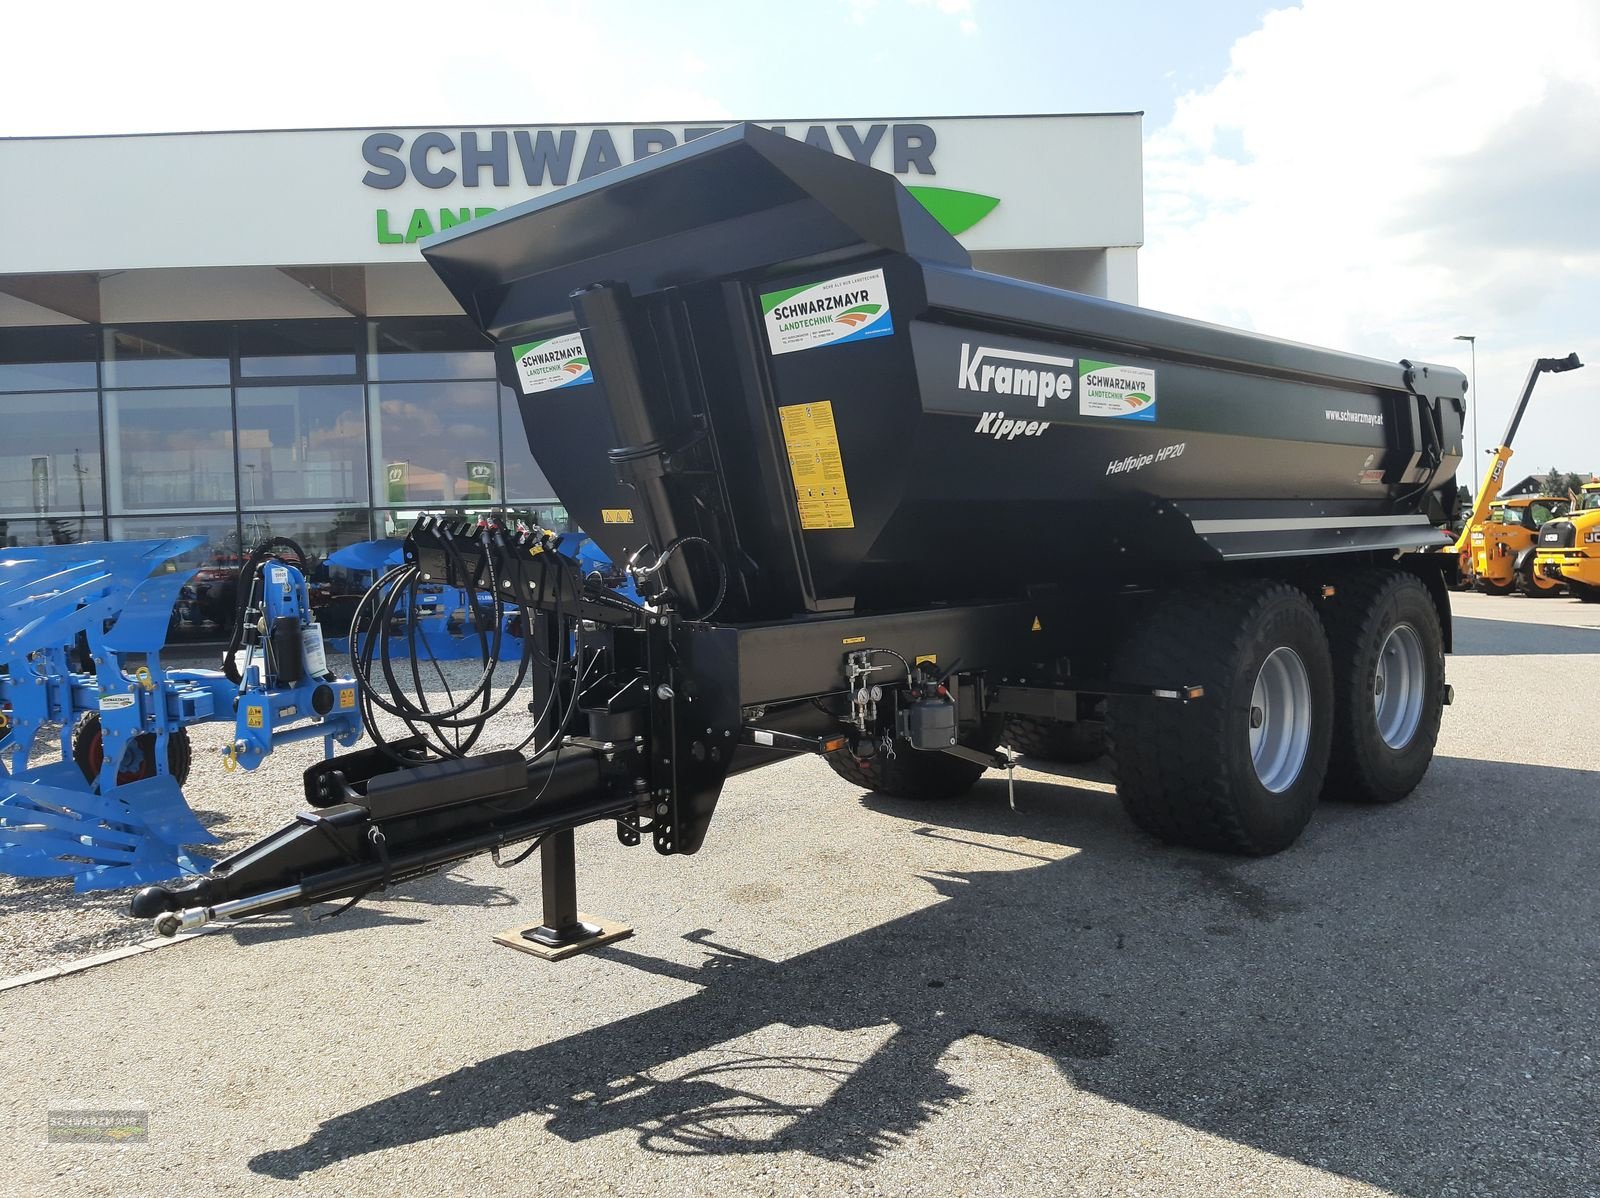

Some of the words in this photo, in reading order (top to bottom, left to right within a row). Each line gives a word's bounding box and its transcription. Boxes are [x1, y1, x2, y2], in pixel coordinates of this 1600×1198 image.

[774, 289, 870, 321] SCHWARZMAYR
[778, 314, 834, 333] LANDTECHNIK
[521, 346, 583, 368] SCHWARZMAYR
[526, 365, 562, 377] LANDTECHNIK
[958, 343, 1074, 408] Krampe
[1086, 374, 1146, 392] SCHWARZMAYR
[1087, 389, 1123, 400] LANDTECHNIK
[974, 411, 1051, 441] Kipper
[1105, 453, 1154, 476] Halfpipe
[1154, 442, 1186, 463] HP20
[1491, 459, 1504, 482] JCB
